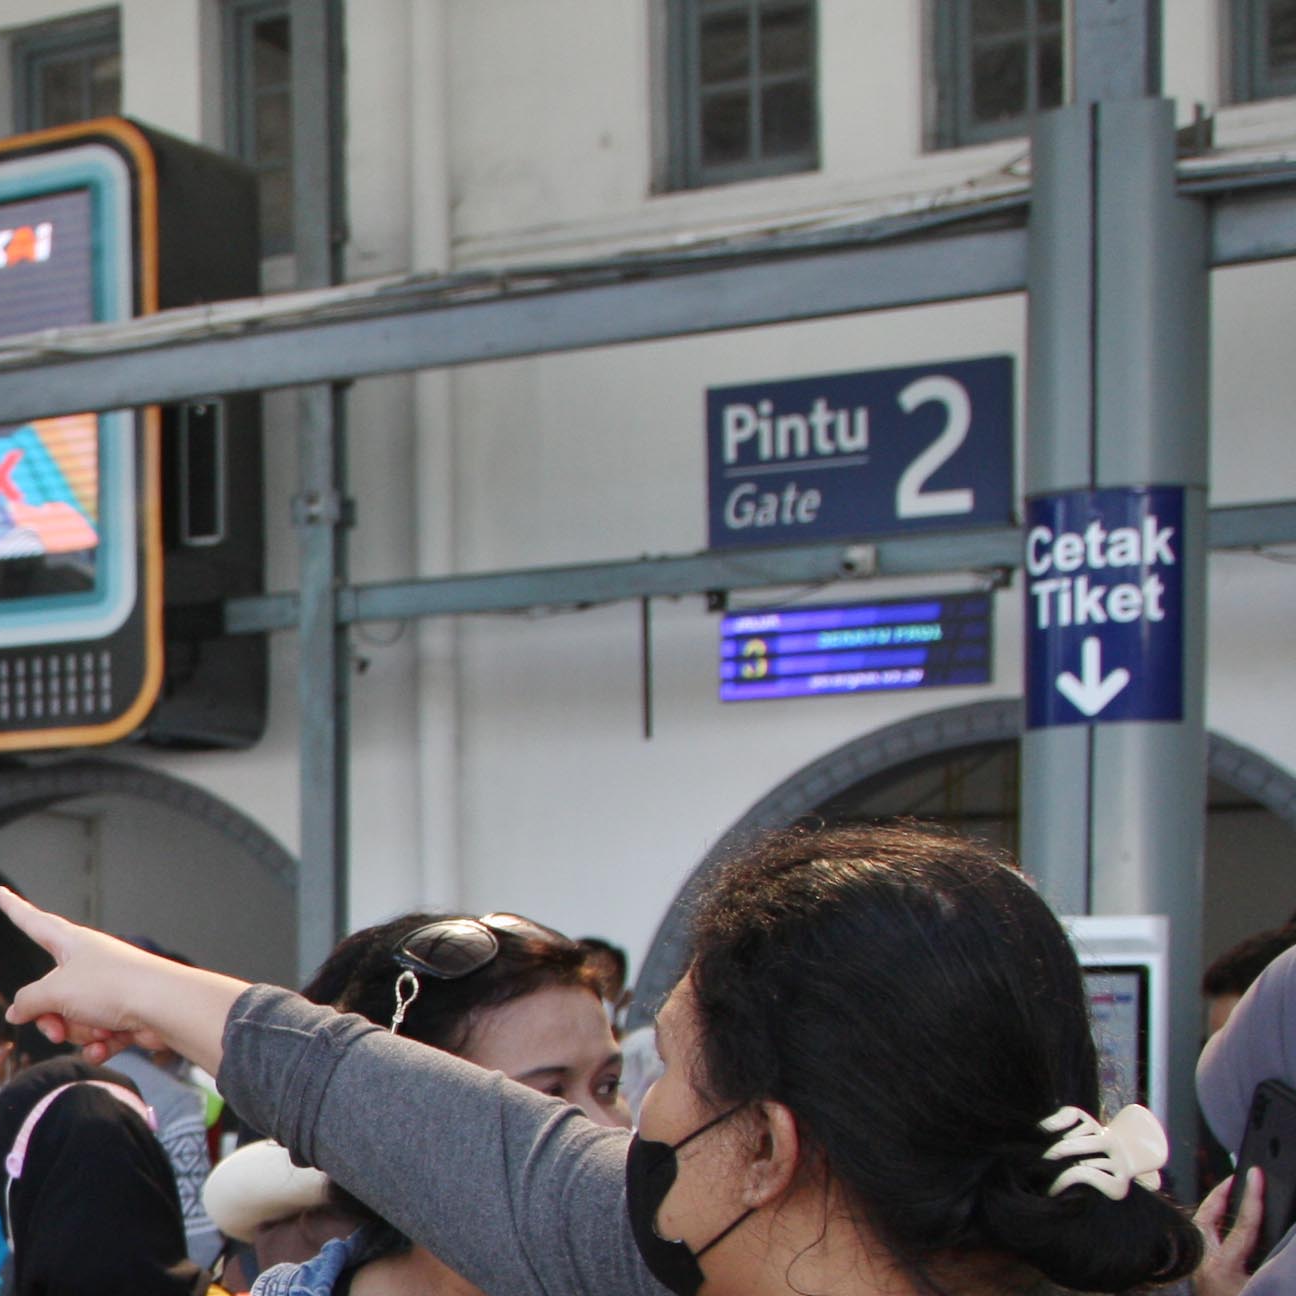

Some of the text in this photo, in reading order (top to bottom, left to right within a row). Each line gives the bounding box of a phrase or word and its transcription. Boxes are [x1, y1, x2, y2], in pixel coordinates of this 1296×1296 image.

[722, 374, 975, 520] Pintu 2
[723, 481, 823, 531] Gate
[1026, 515, 1176, 577] Cetak
[1030, 574, 1166, 630] Tiket
[740, 638, 769, 680] 3
